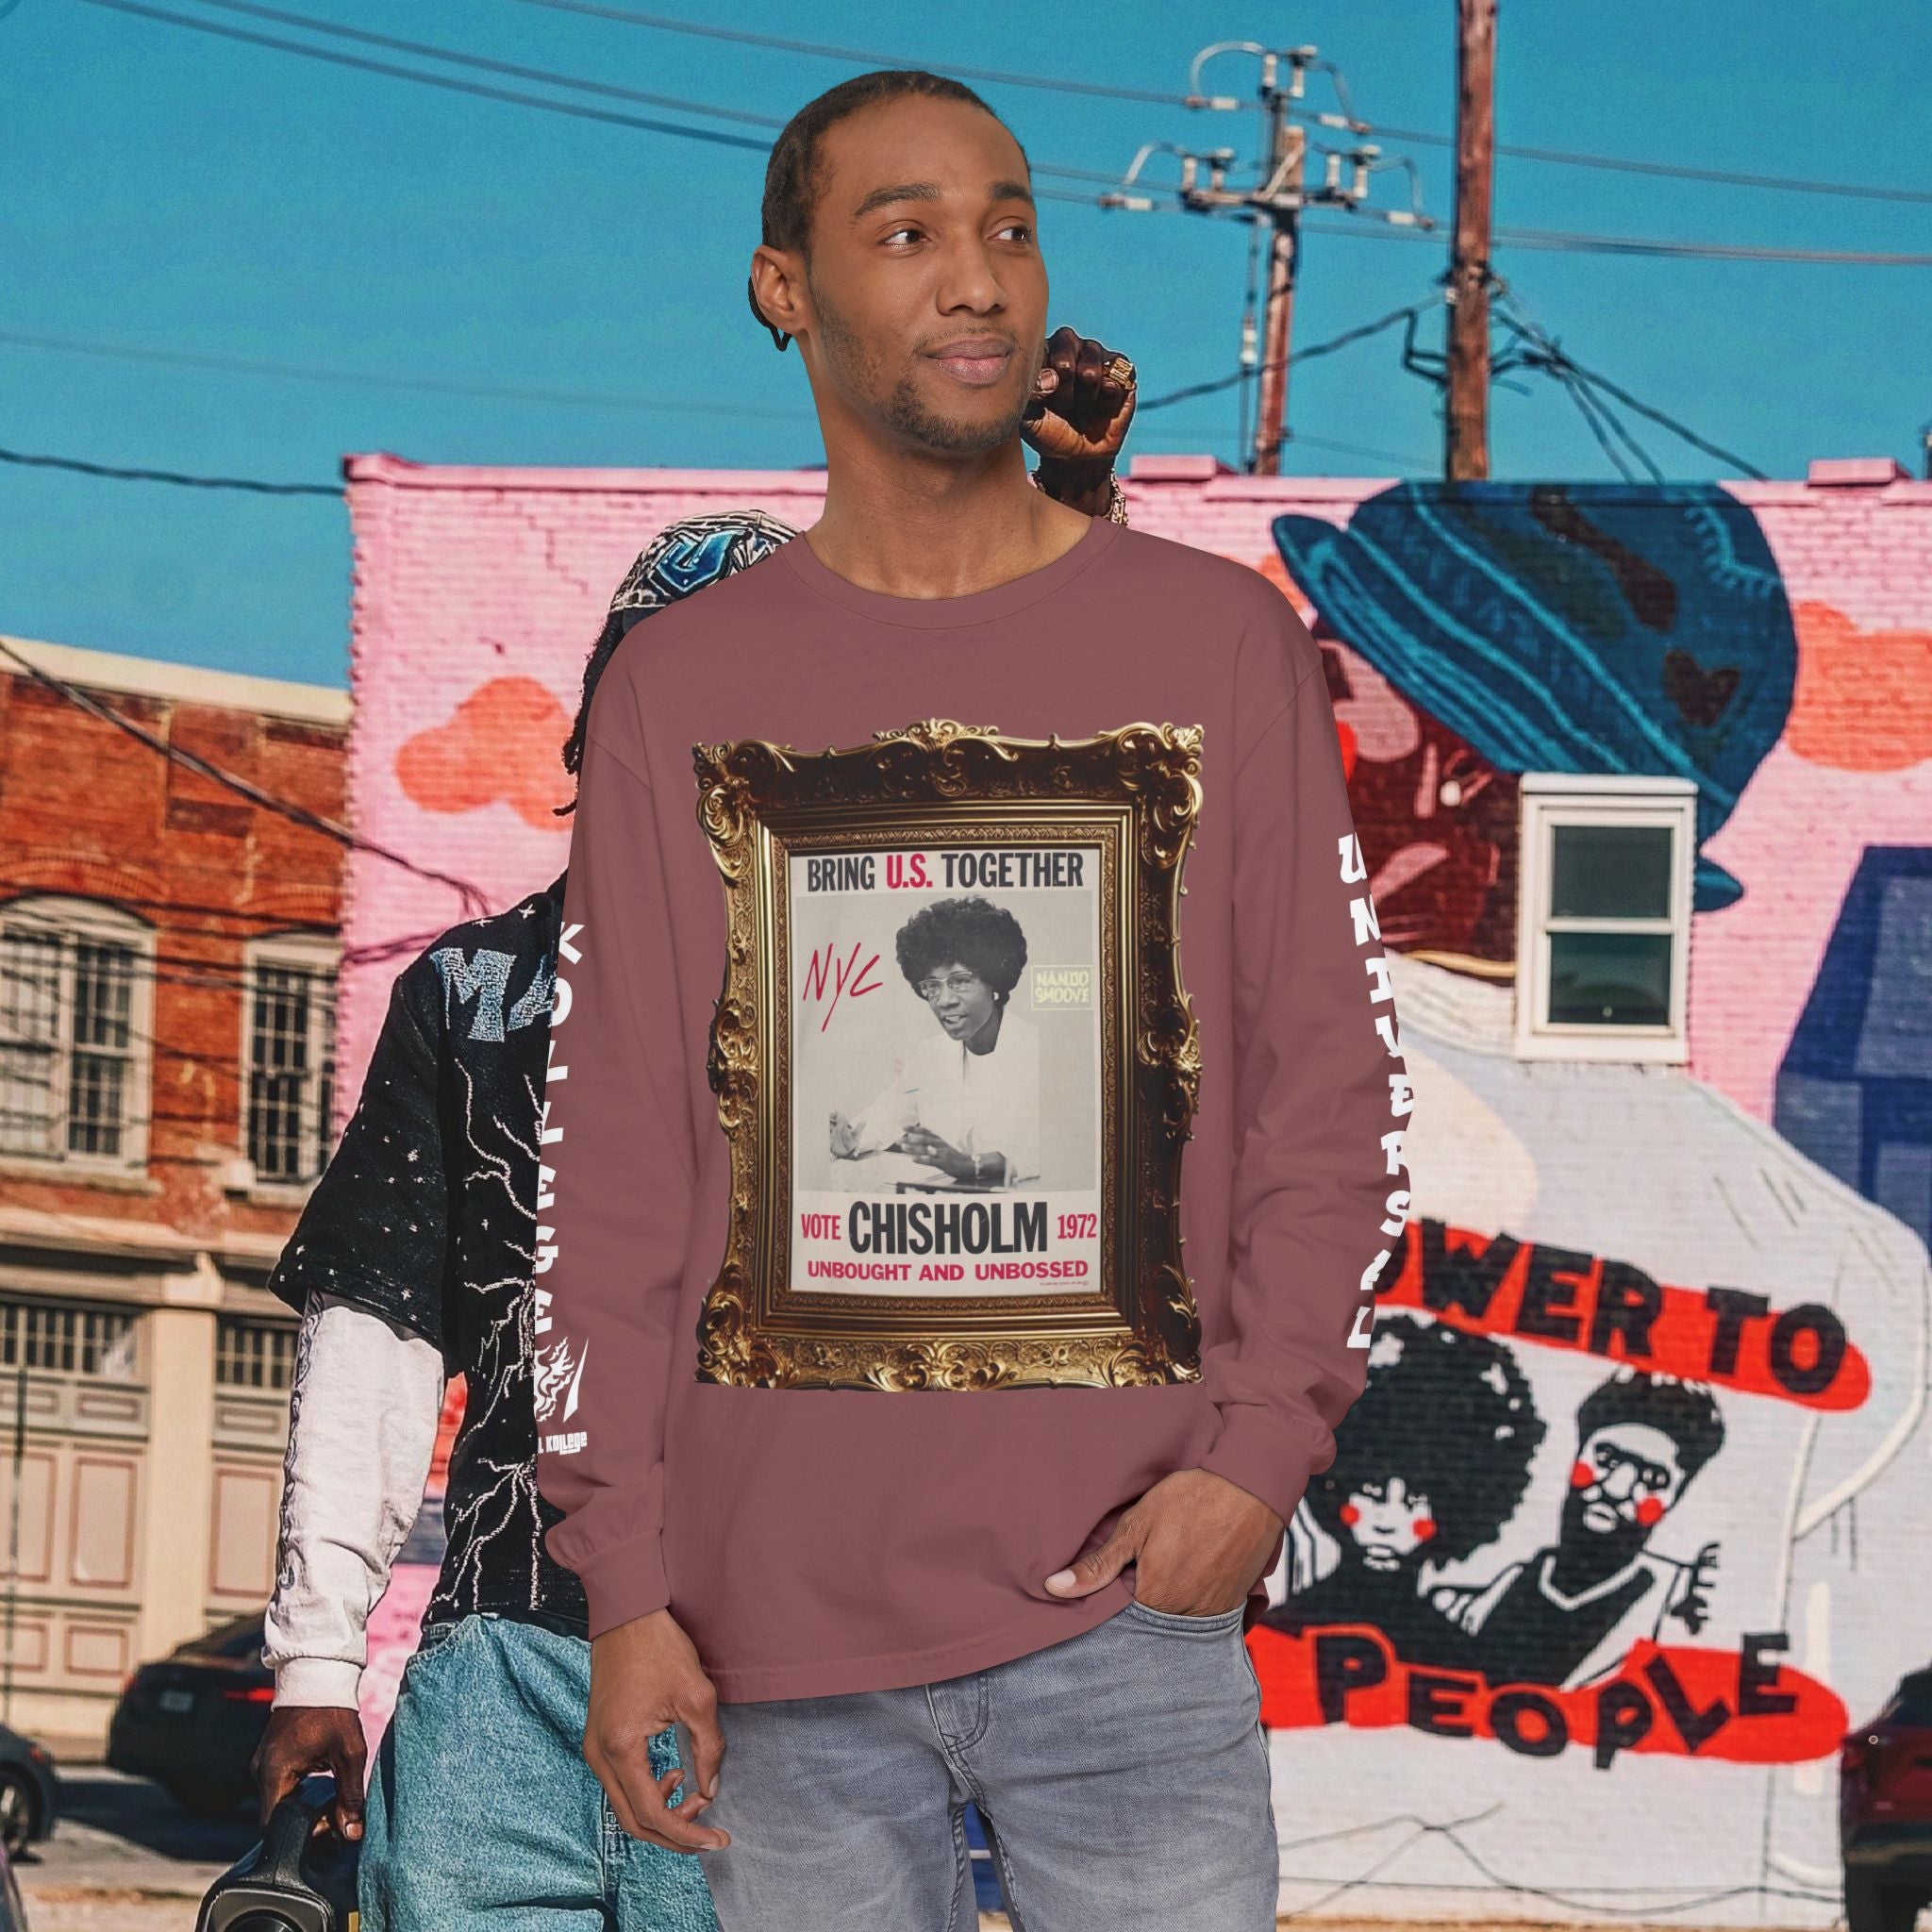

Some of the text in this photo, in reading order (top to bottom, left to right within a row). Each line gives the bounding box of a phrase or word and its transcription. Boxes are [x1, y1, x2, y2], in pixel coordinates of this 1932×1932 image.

[808, 852, 1084, 891] BRING U.S. TOGETHER
[803, 941, 884, 1032] NYC
[801, 1200, 1098, 1256] VOTE CHISHOLM 1972
[808, 1259, 1090, 1282] UNBOUGHT AND UNBOSSED
[1707, 1286, 1847, 1395] TO
[1315, 1632, 1799, 1771] PEOPLE
